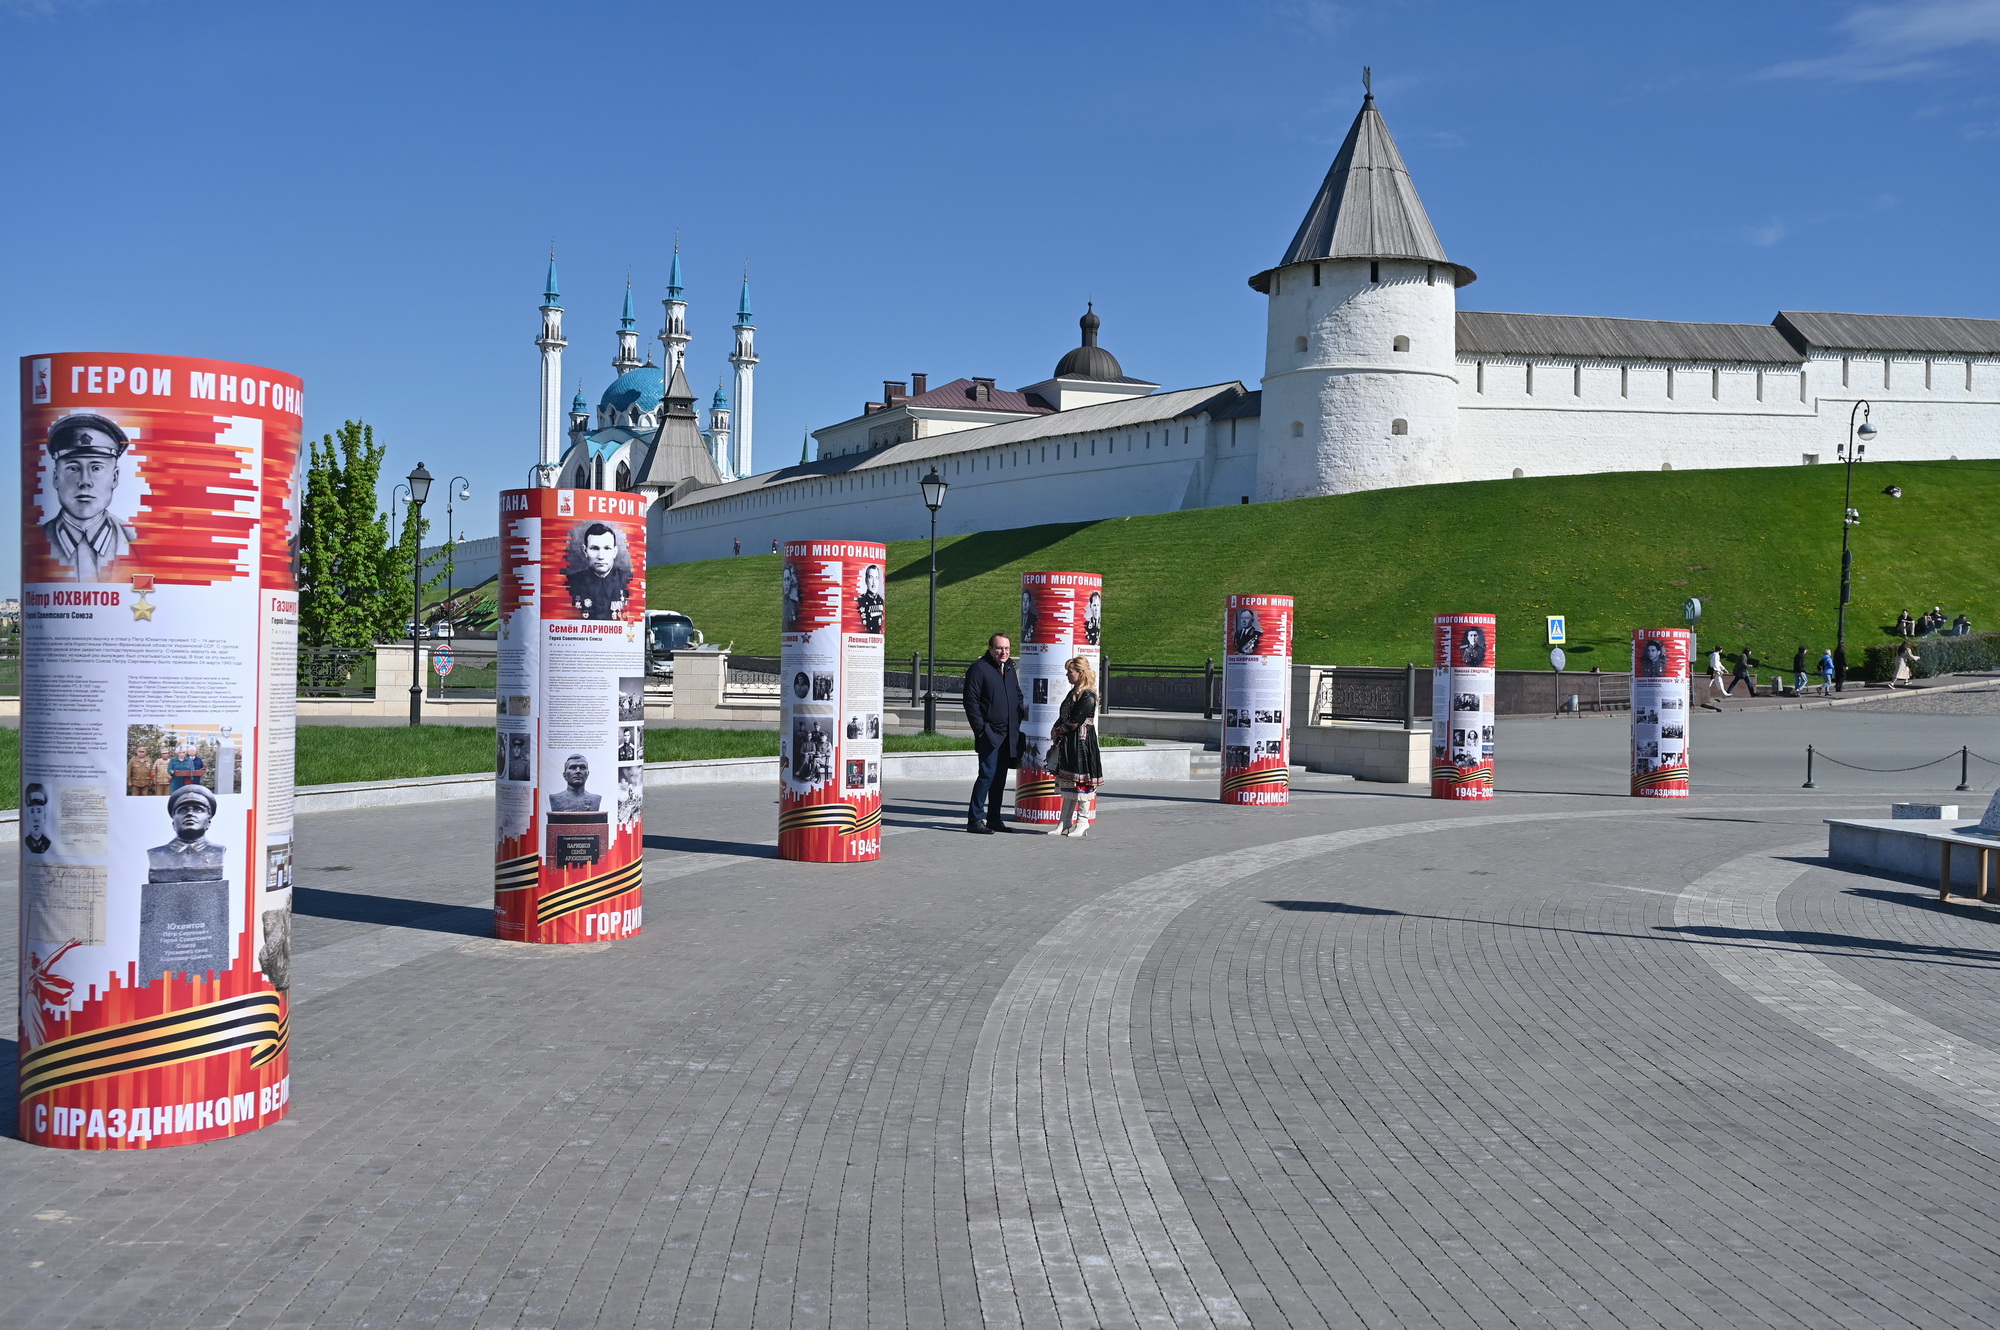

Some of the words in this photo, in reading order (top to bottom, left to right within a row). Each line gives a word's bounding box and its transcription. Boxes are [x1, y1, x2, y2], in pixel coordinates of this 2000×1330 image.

[71, 366, 172, 396] ГЕРОИ
[190, 371, 304, 418] МНОГОНА
[588, 496, 635, 515] ГЕРОИ
[783, 545, 807, 558] ГЕРОИ
[1023, 575, 1046, 584] ГЕРОИ
[25, 591, 50, 609] Пётр
[53, 591, 120, 606] ЮХВИТОВ
[1241, 597, 1268, 606] ГЕРОИ
[37, 611, 69, 620] Советского
[71, 611, 93, 620] Союза
[549, 623, 578, 634] Семён
[580, 624, 623, 635] ЛАРИОНОВ
[1648, 630, 1671, 638] ГЕРОИ
[848, 635, 868, 644] Леонид
[1640, 788, 1645, 796] С
[35, 1103, 47, 1133] С
[52, 1091, 255, 1142] ПРАЗДНИКОМ
